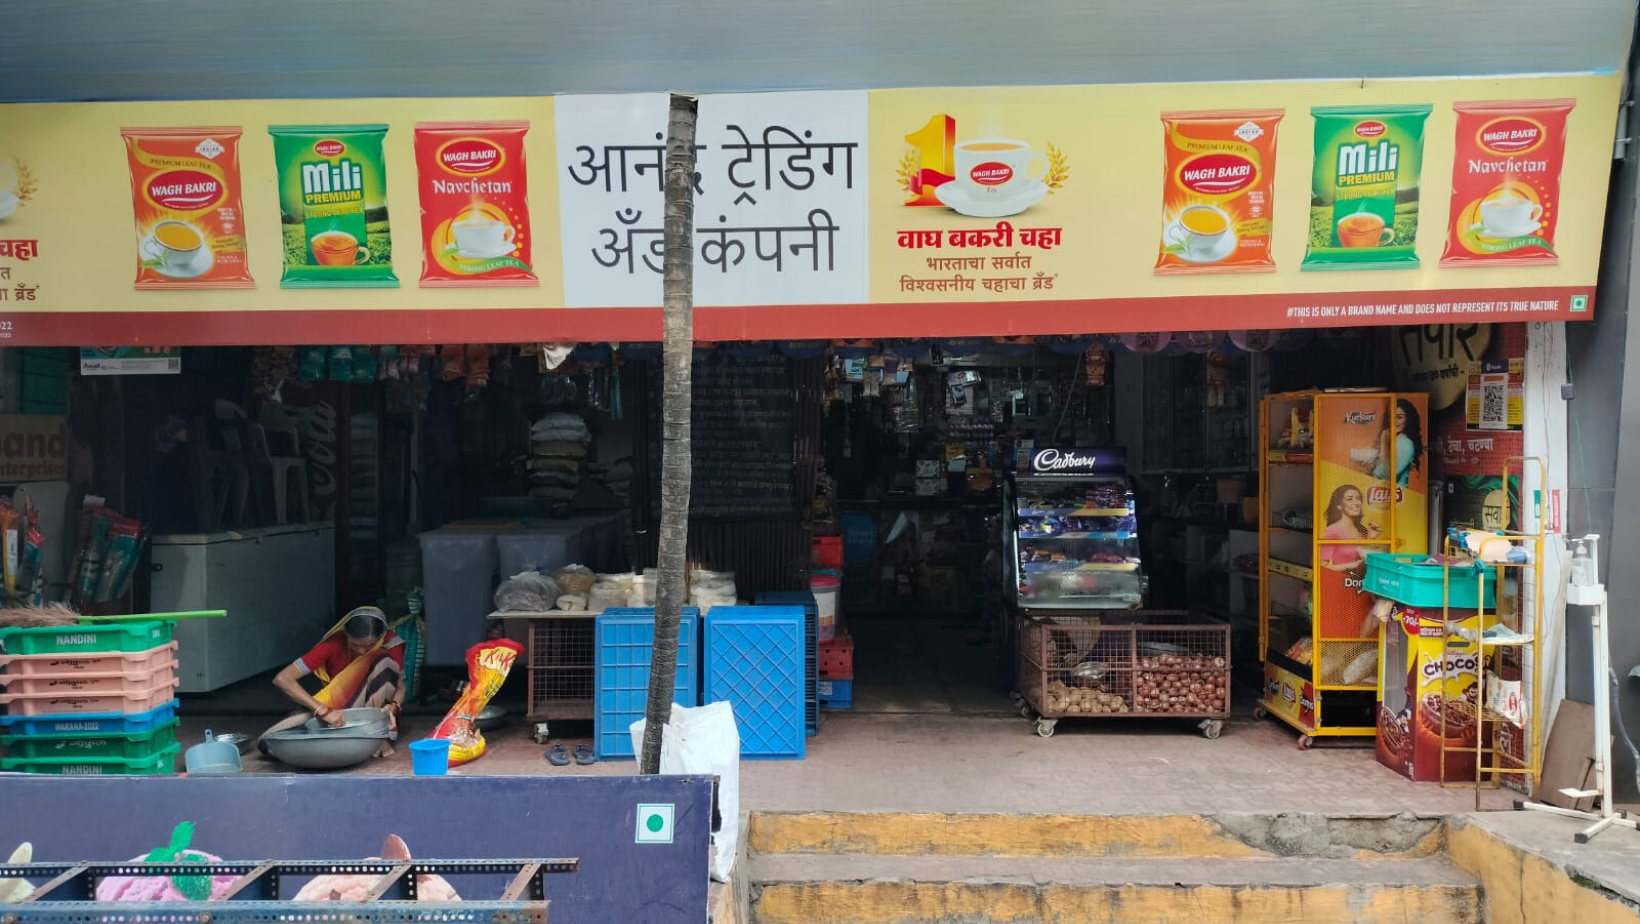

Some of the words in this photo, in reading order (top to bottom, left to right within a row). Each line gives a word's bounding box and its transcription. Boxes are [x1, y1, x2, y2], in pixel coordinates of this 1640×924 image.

[1484, 132, 1509, 141] WAGH
[1511, 129, 1537, 139] BAKRI
[1187, 142, 1218, 150] PREMIUM
[444, 152, 468, 162] WAGH
[470, 150, 496, 160] BAKRI
[151, 158, 182, 167] PREMIUM
[182, 159, 196, 168] LEAF
[198, 161, 212, 170] TEA
[568, 132, 707, 195] आनं
[722, 124, 858, 206] ट्रेडिंग
[1468, 159, 1547, 174] Navchetan
[1184, 168, 1216, 180] WAGH
[1218, 165, 1250, 178] BAKRI
[1339, 172, 1395, 186] PREMIUM
[152, 184, 182, 197] WAGH
[185, 182, 216, 194] BAKRI
[432, 180, 512, 194] Navchetan
[306, 190, 361, 204] PREMIUM
[1336, 192, 1363, 200] STRONG
[306, 210, 332, 218] STRONG
[696, 208, 840, 273] कंपनी
[897, 230, 943, 248] वाघ
[948, 221, 1014, 248] बकरी
[1019, 228, 1062, 250] चहा
[1481, 243, 1507, 251] STRONG
[1508, 241, 1526, 249] LEAF
[1528, 238, 1542, 246] TEA
[459, 263, 486, 272] STRONG
[486, 262, 504, 270] LEAF
[926, 257, 985, 271] भारताचा
[992, 252, 1032, 270] सर्वात
[900, 274, 976, 292] विश्वसनीय
[982, 278, 1026, 292] चहाचा
[1287, 306, 1310, 318] #THIS
[1312, 306, 1320, 317] IS
[1320, 306, 1340, 317] ONLY
[1340, 306, 1347, 316] A
[1348, 304, 1374, 316] BRAND
[1375, 304, 1397, 315] NAME
[1398, 304, 1414, 314] AND
[1415, 303, 1434, 314] DOES
[1436, 302, 1450, 314] NOT
[1452, 302, 1495, 313] REPRESENT
[1496, 302, 1508, 312] ITS
[1510, 300, 1528, 312] TRUE
[1530, 300, 1559, 312] NATURE
[1034, 448, 1096, 472] Cadbury
[56, 634, 97, 646] NANDINI
[55, 722, 99, 730] WARANA-2022
[62, 765, 102, 774] NANDINI
